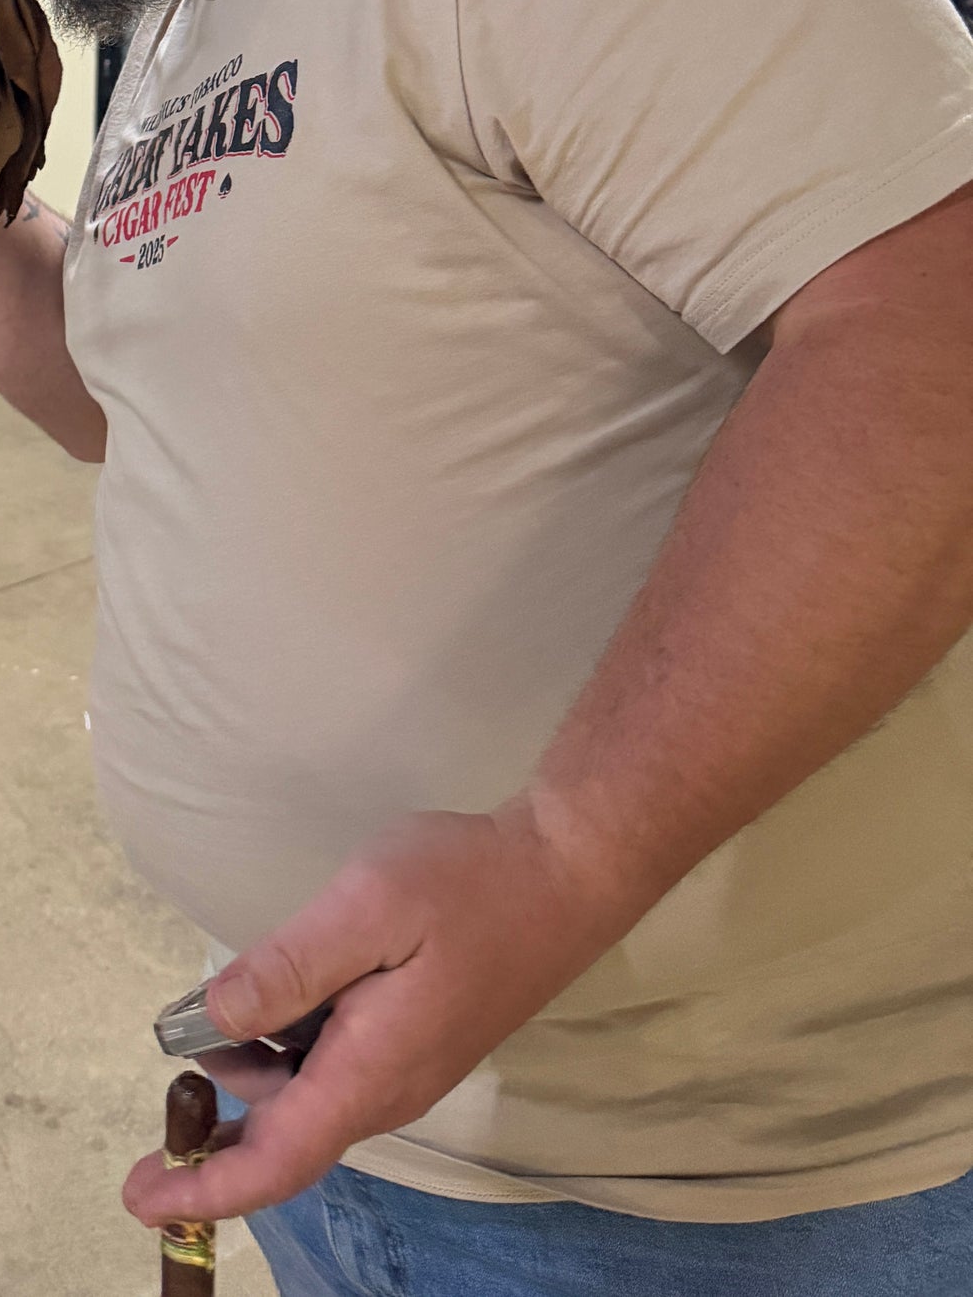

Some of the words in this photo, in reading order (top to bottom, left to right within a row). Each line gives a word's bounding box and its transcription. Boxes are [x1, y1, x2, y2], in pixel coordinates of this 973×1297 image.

[190, 54, 243, 109] TOBACCO
[90, 124, 175, 223] GREAT
[167, 59, 298, 179] LAKES
[102, 191, 162, 248] CIGAR
[164, 170, 216, 224] FEST
[137, 234, 166, 270] 2025
